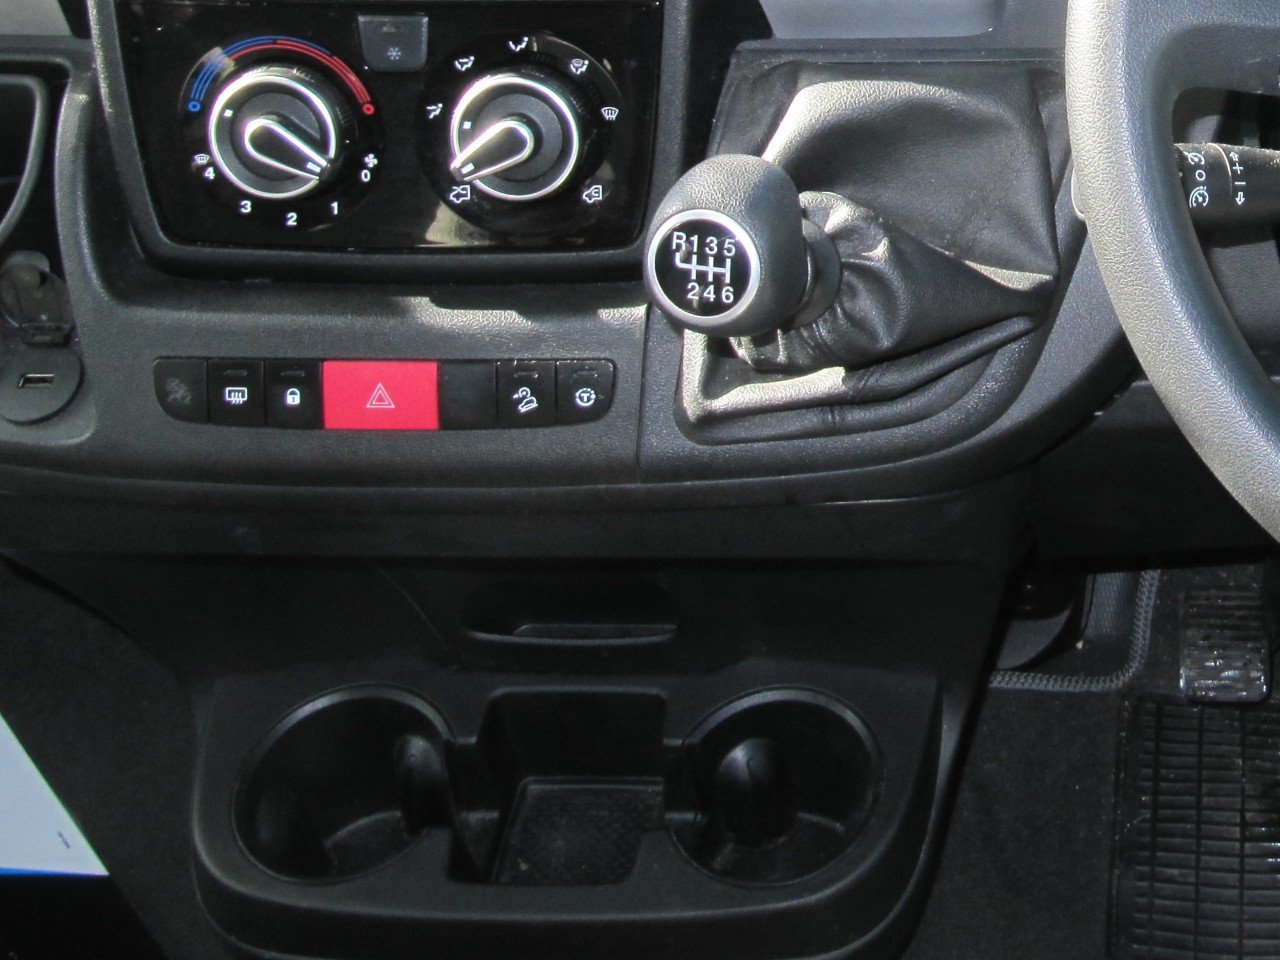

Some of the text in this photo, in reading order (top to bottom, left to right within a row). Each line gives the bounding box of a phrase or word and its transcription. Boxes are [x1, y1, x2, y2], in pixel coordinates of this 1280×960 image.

[204, 167, 215, 180] 4
[240, 200, 251, 213] 3
[331, 201, 339, 215] 1
[286, 212, 297, 226] 2
